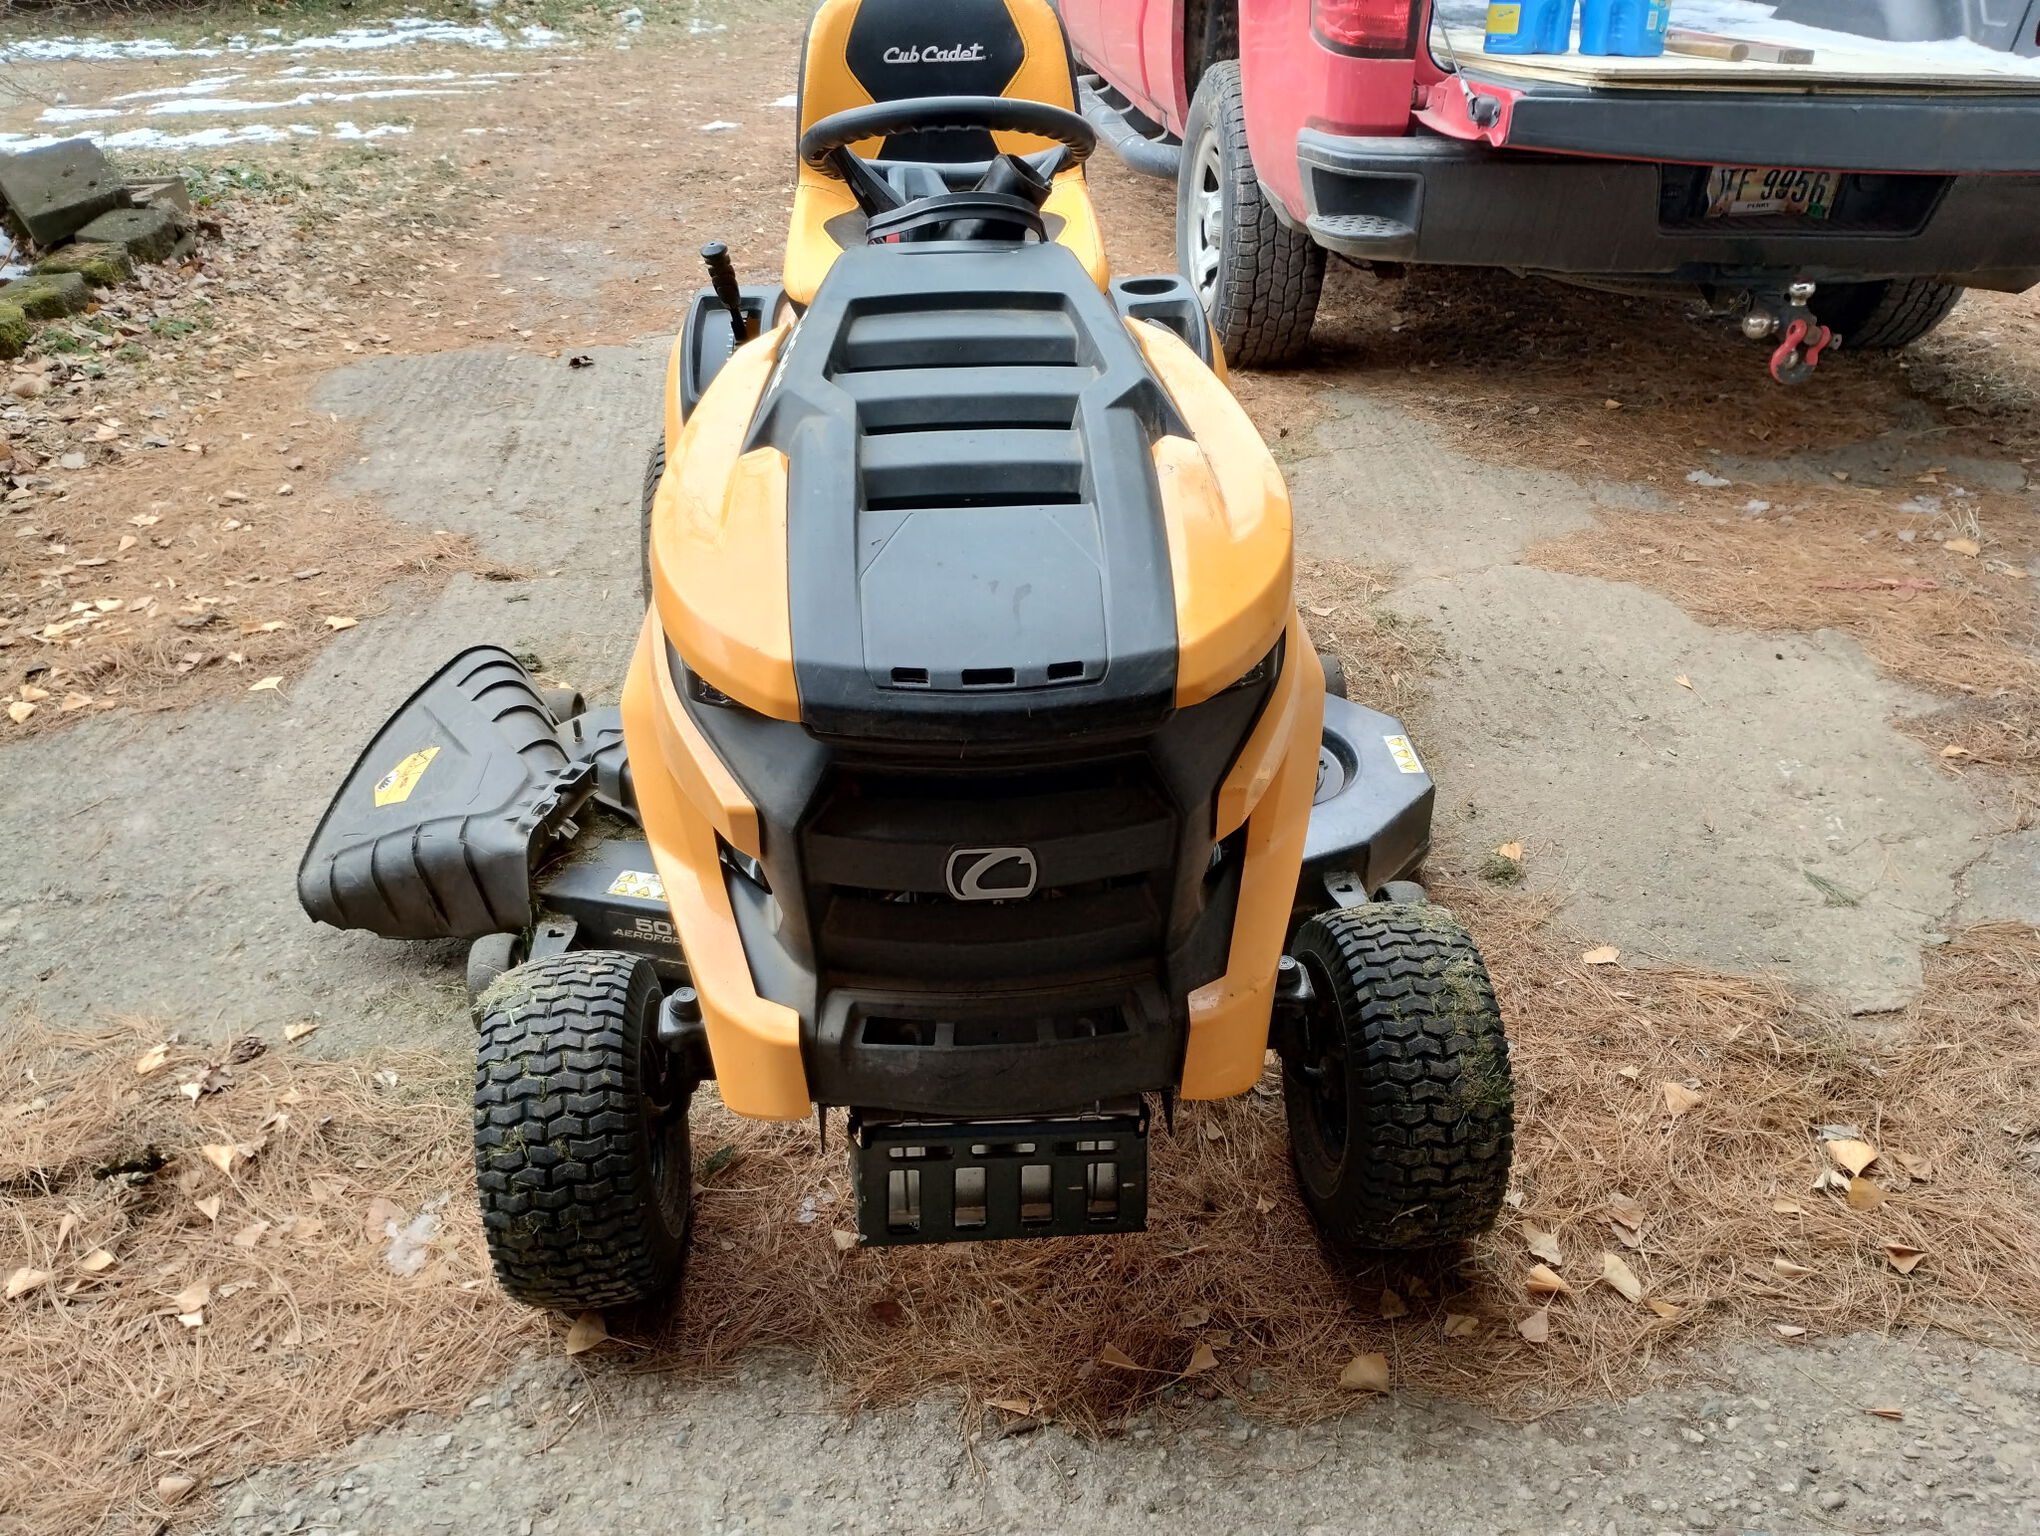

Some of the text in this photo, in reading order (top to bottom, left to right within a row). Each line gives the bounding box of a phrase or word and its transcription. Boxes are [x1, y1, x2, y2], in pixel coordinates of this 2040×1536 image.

[883, 42, 984, 63] Cub Cadet
[1760, 169, 1830, 203] 9956
